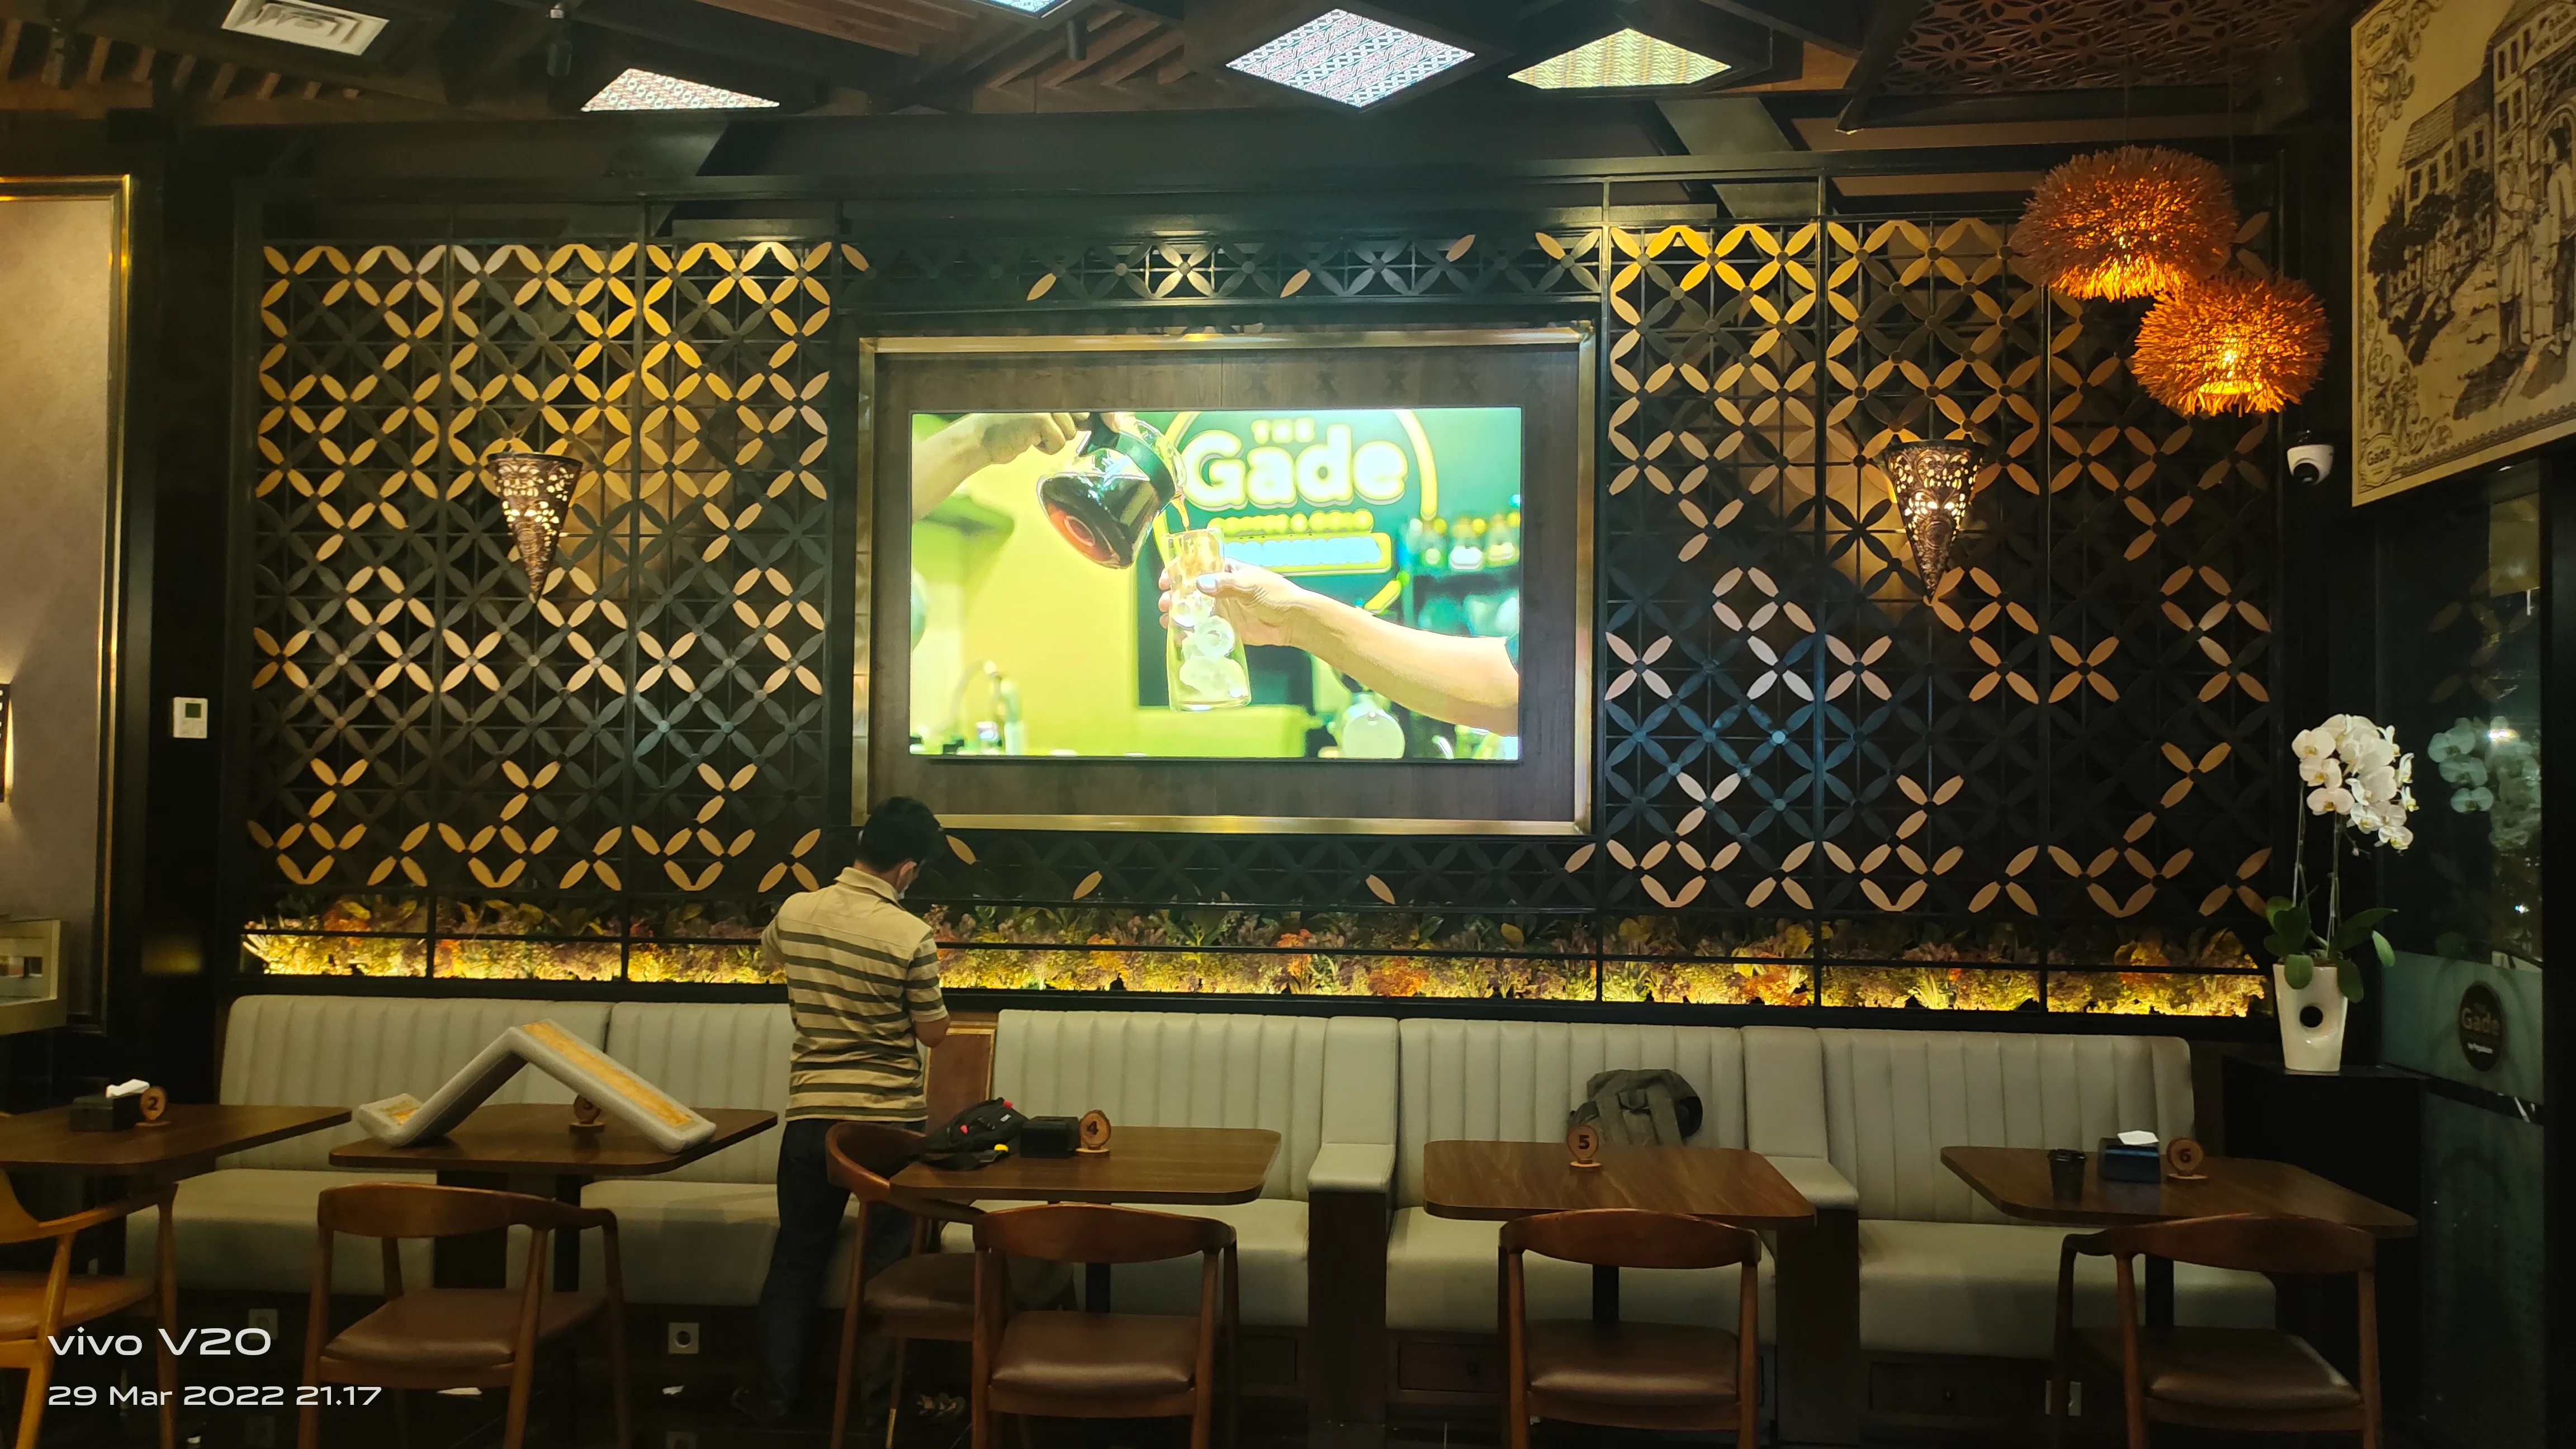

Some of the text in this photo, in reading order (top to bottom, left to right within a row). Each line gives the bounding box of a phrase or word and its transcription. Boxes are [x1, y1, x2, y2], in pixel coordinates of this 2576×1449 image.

[2367, 446, 2390, 466] Gade
[1180, 424, 1409, 509] Gade
[2461, 1007, 2500, 1035] Gade
[147, 1096, 158, 1110] 2
[1087, 1120, 1099, 1135] 4
[1578, 1135, 1590, 1149] 5
[2179, 1148, 2192, 1163] 6
